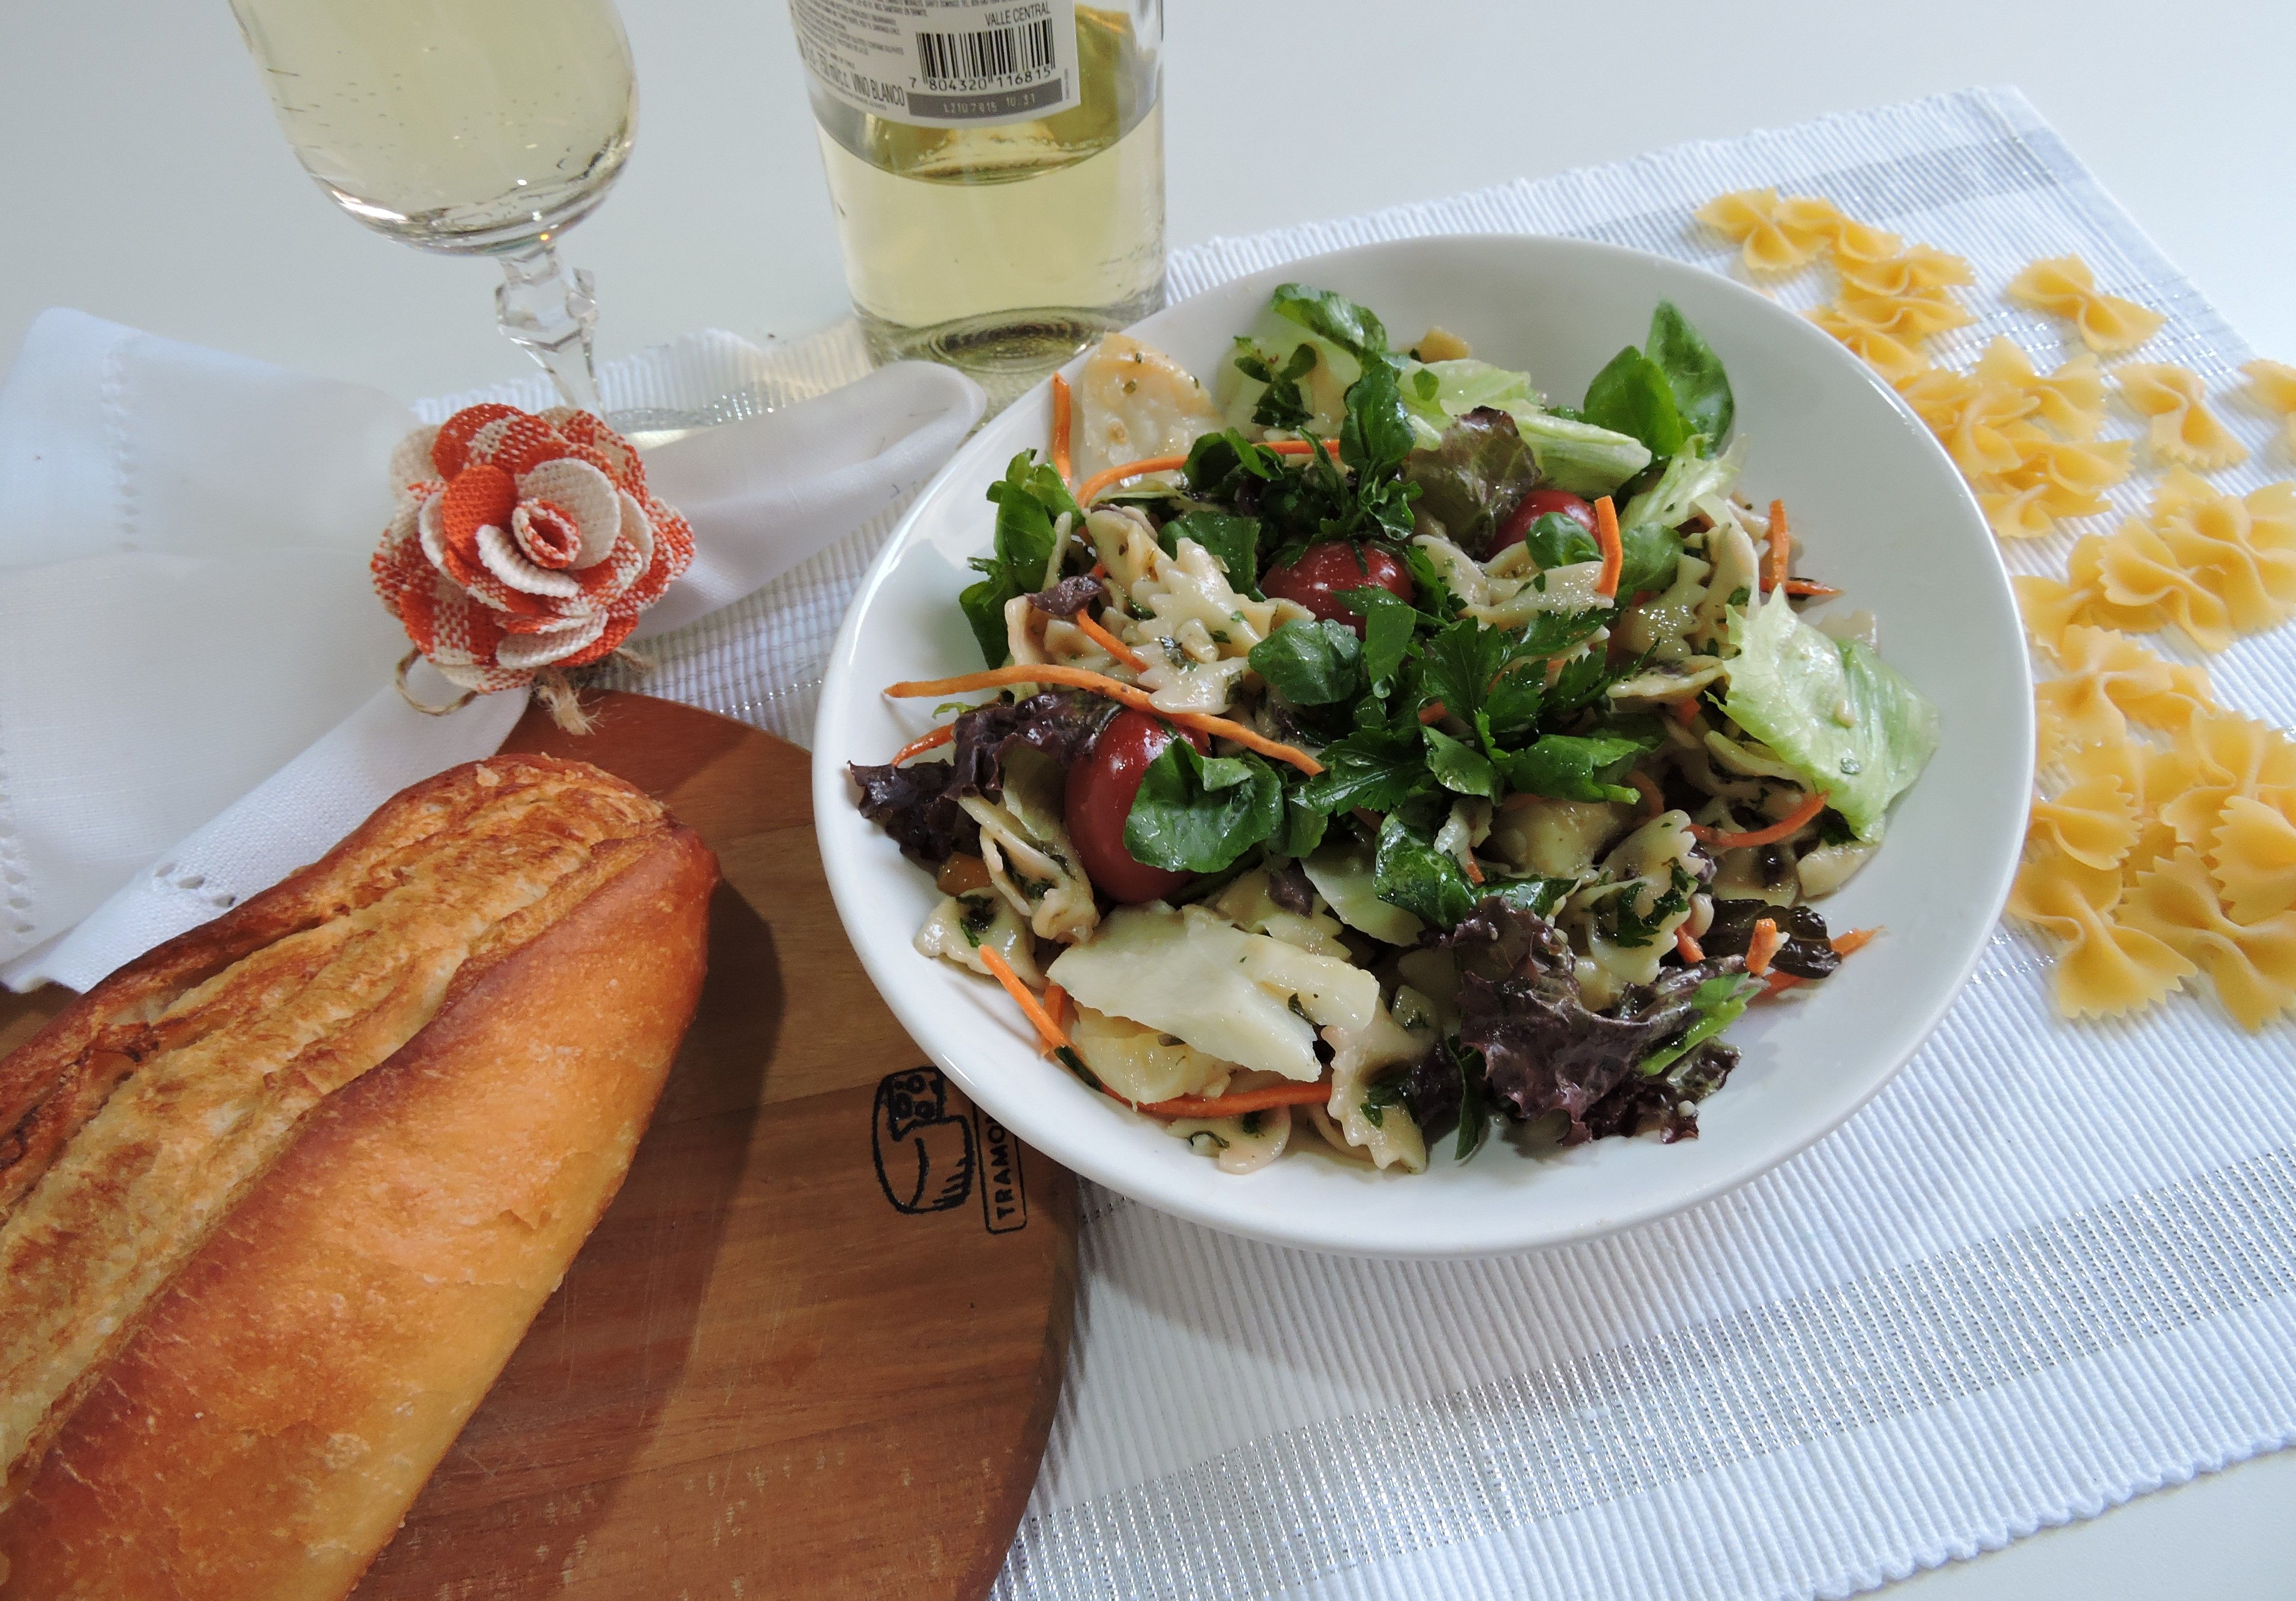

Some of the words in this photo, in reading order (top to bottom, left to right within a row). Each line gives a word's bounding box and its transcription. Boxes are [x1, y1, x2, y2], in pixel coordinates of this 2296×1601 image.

[984, 11, 1011, 26] VALLE
[1012, 2, 1050, 22] CENTRAL
[851, 72, 870, 98] VINO
[870, 79, 905, 106] BLANCO
[909, 76, 917, 88] 7
[929, 77, 987, 91] 804320
[998, 68, 1051, 88] 116815
[985, 1115, 1015, 1220] TRAMO
